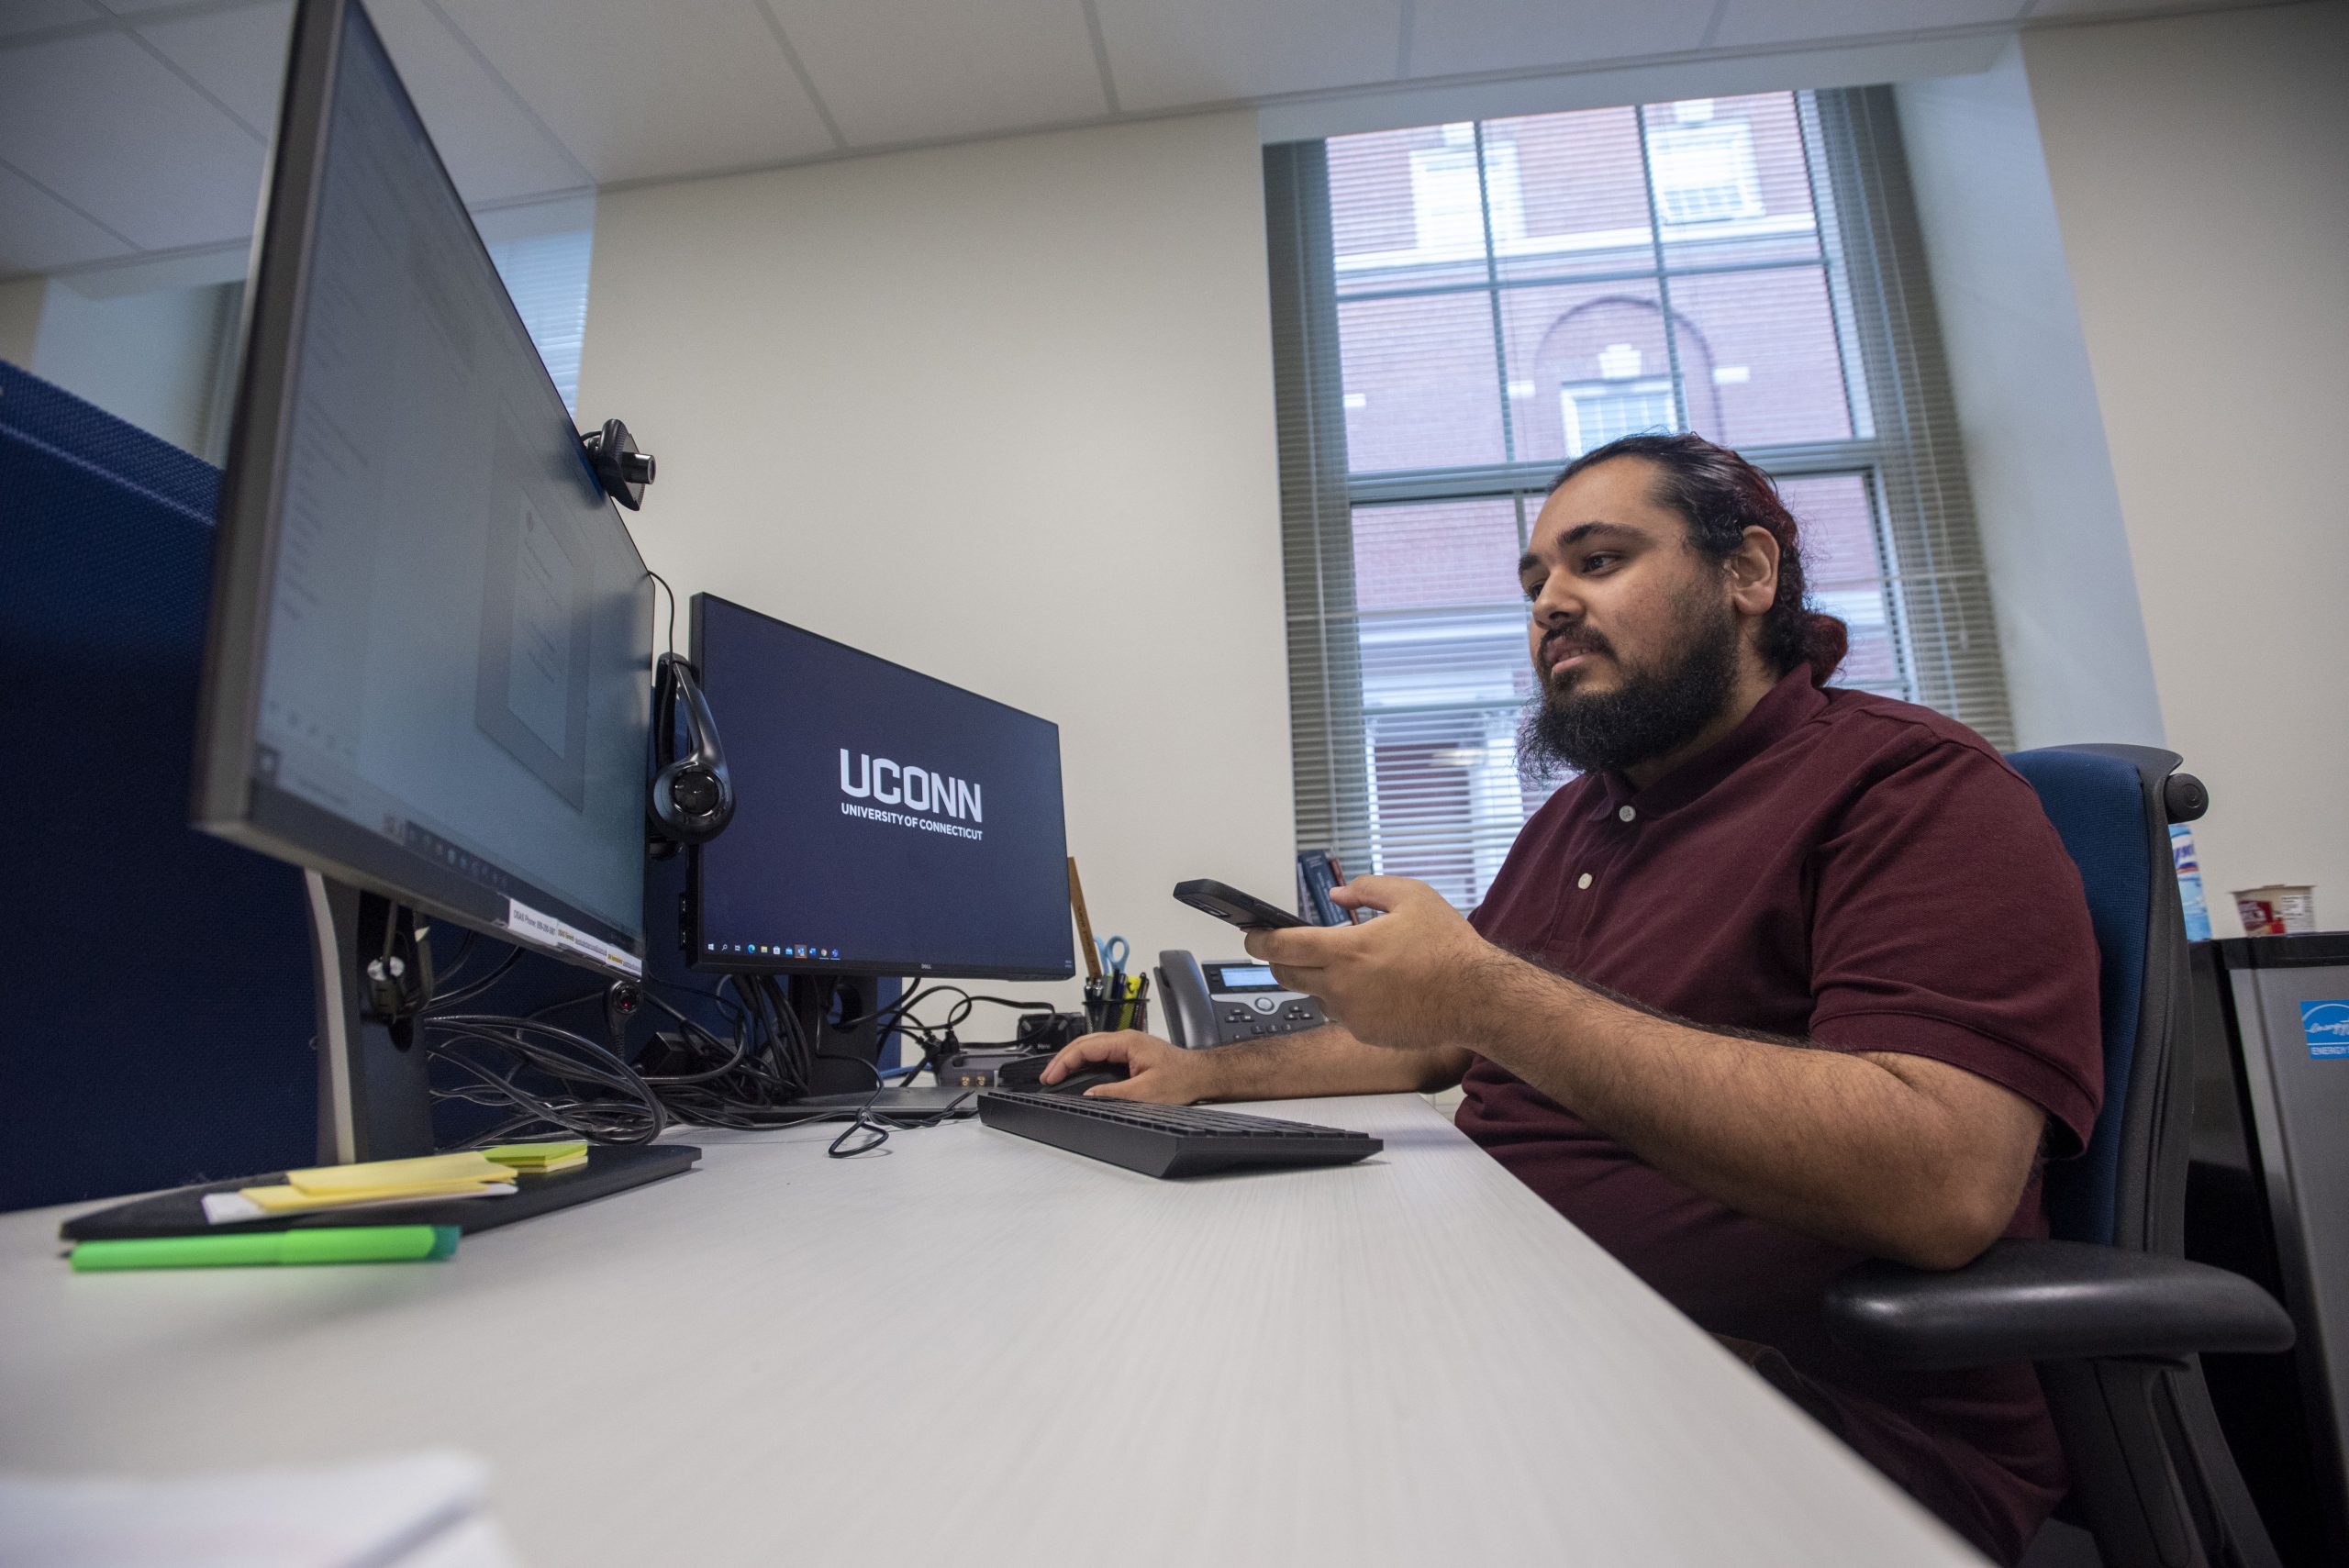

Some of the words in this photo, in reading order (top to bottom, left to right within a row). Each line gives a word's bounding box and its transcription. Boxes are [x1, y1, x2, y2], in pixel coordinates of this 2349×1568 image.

[841, 749, 982, 823] UCONN
[841, 802, 904, 825] UNIVERSITY
[904, 816, 918, 828] OF
[919, 818, 984, 841] CONNECTICUT
